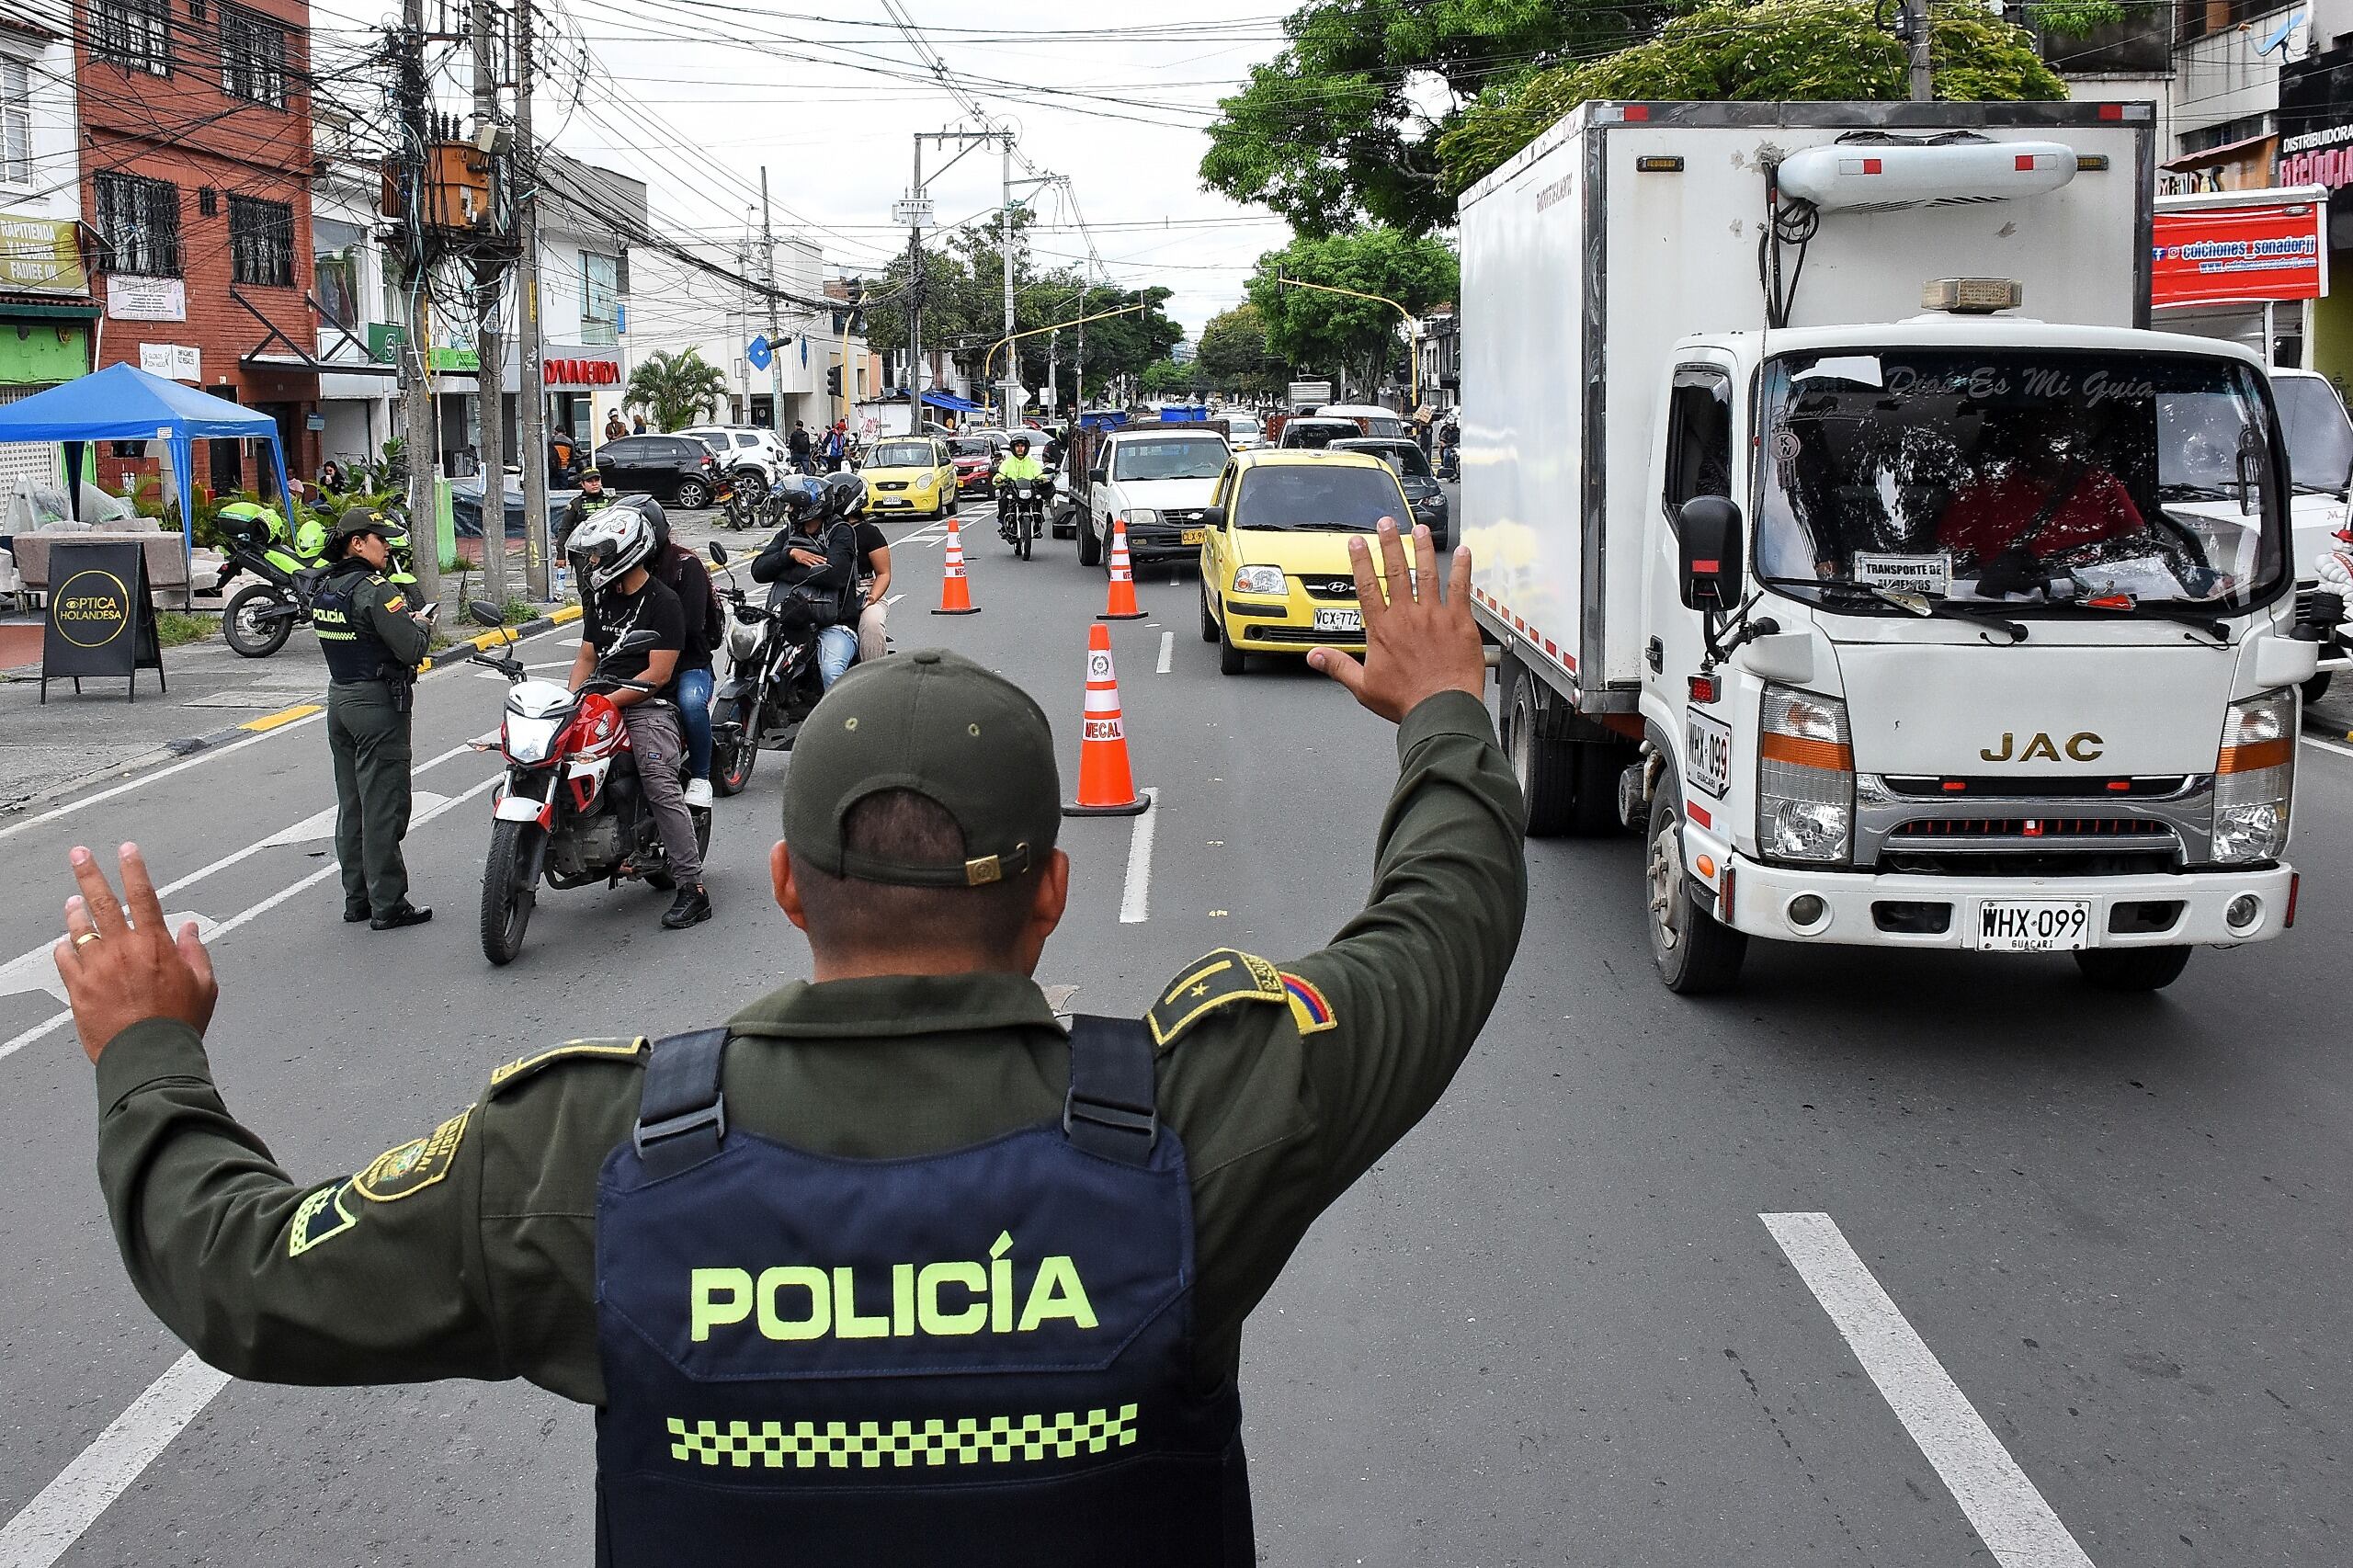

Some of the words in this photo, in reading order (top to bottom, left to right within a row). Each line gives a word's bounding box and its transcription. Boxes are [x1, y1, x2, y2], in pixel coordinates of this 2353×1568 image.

[2283, 124, 2353, 153] DISTRIBUIDORA
[1968, 367, 2011, 398] Es
[2022, 367, 2072, 397] Mi
[1866, 564, 1928, 574] TRANSPORTE
[1929, 564, 1941, 574] DE
[60, 610, 121, 620] HOLANDESA
[313, 608, 347, 624] POLICÍA
[1980, 732, 2104, 762] JAC
[2011, 939, 2054, 949] GUACARI
[691, 1230, 1100, 1342] POLICÍA
